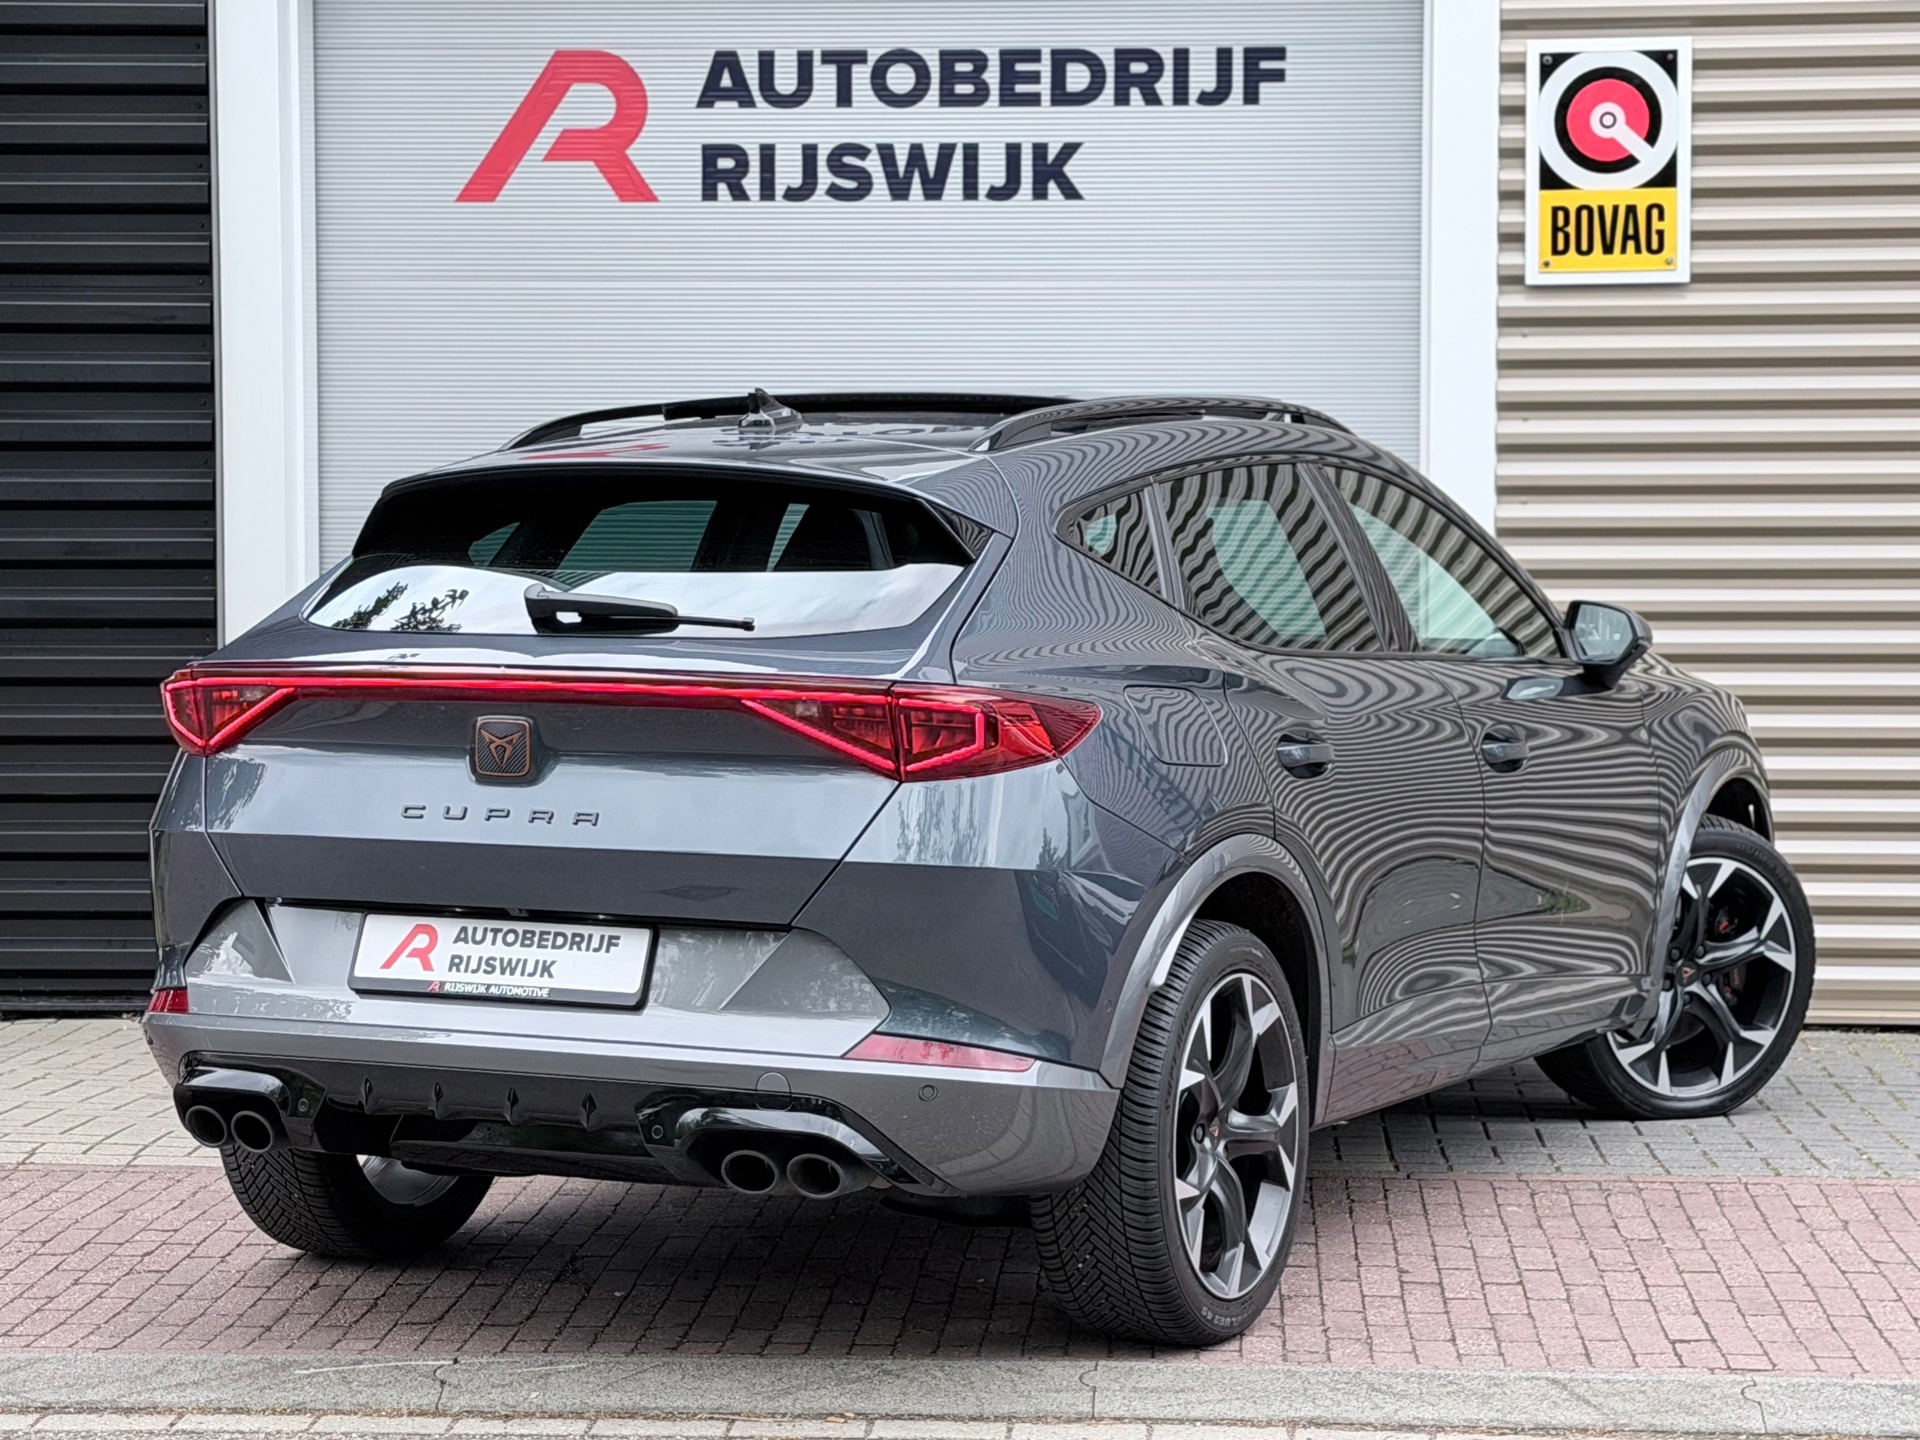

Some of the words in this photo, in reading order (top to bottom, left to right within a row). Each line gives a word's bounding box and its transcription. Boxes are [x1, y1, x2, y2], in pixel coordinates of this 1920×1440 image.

[695, 46, 1288, 109] AUTOBEDRIJF
[701, 142, 1086, 202] RIJSWIJK
[1550, 203, 1666, 257] BOVAG
[401, 804, 601, 827] CUPRA
[452, 925, 622, 954] AUTOBEDRIJF
[448, 953, 558, 979] RIJSWIJK
[444, 982, 487, 995] RIJSWIJK
[488, 985, 551, 998] AUTOMOTIVE
